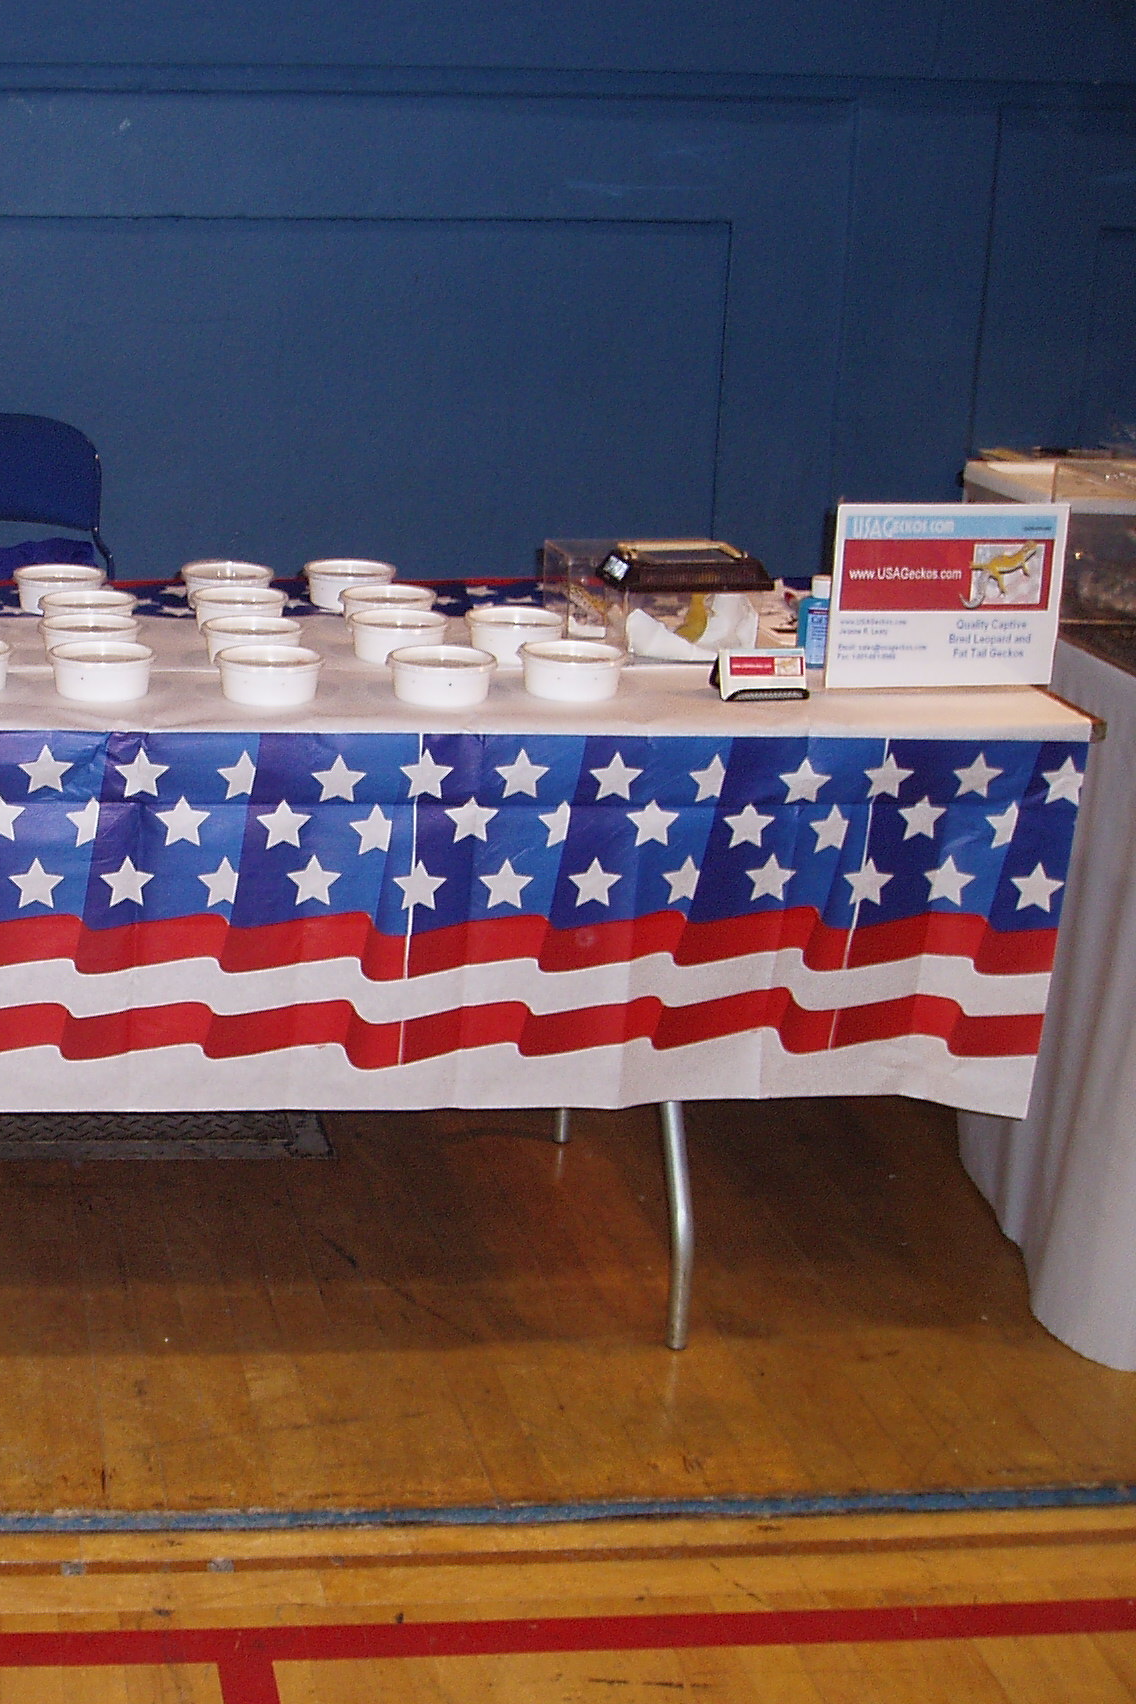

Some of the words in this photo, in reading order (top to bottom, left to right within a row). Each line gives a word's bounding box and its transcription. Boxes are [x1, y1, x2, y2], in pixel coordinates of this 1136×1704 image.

[848, 567, 962, 581] www.USAGeckos.com
[956, 619, 989, 630] Quality
[991, 619, 1027, 631] Captive
[949, 633, 971, 643] Bred
[974, 634, 1012, 645] Leopard
[1014, 633, 1032, 643] and
[953, 648, 968, 657] Fat
[971, 648, 987, 657] Tail
[990, 648, 1024, 658] Geckos
